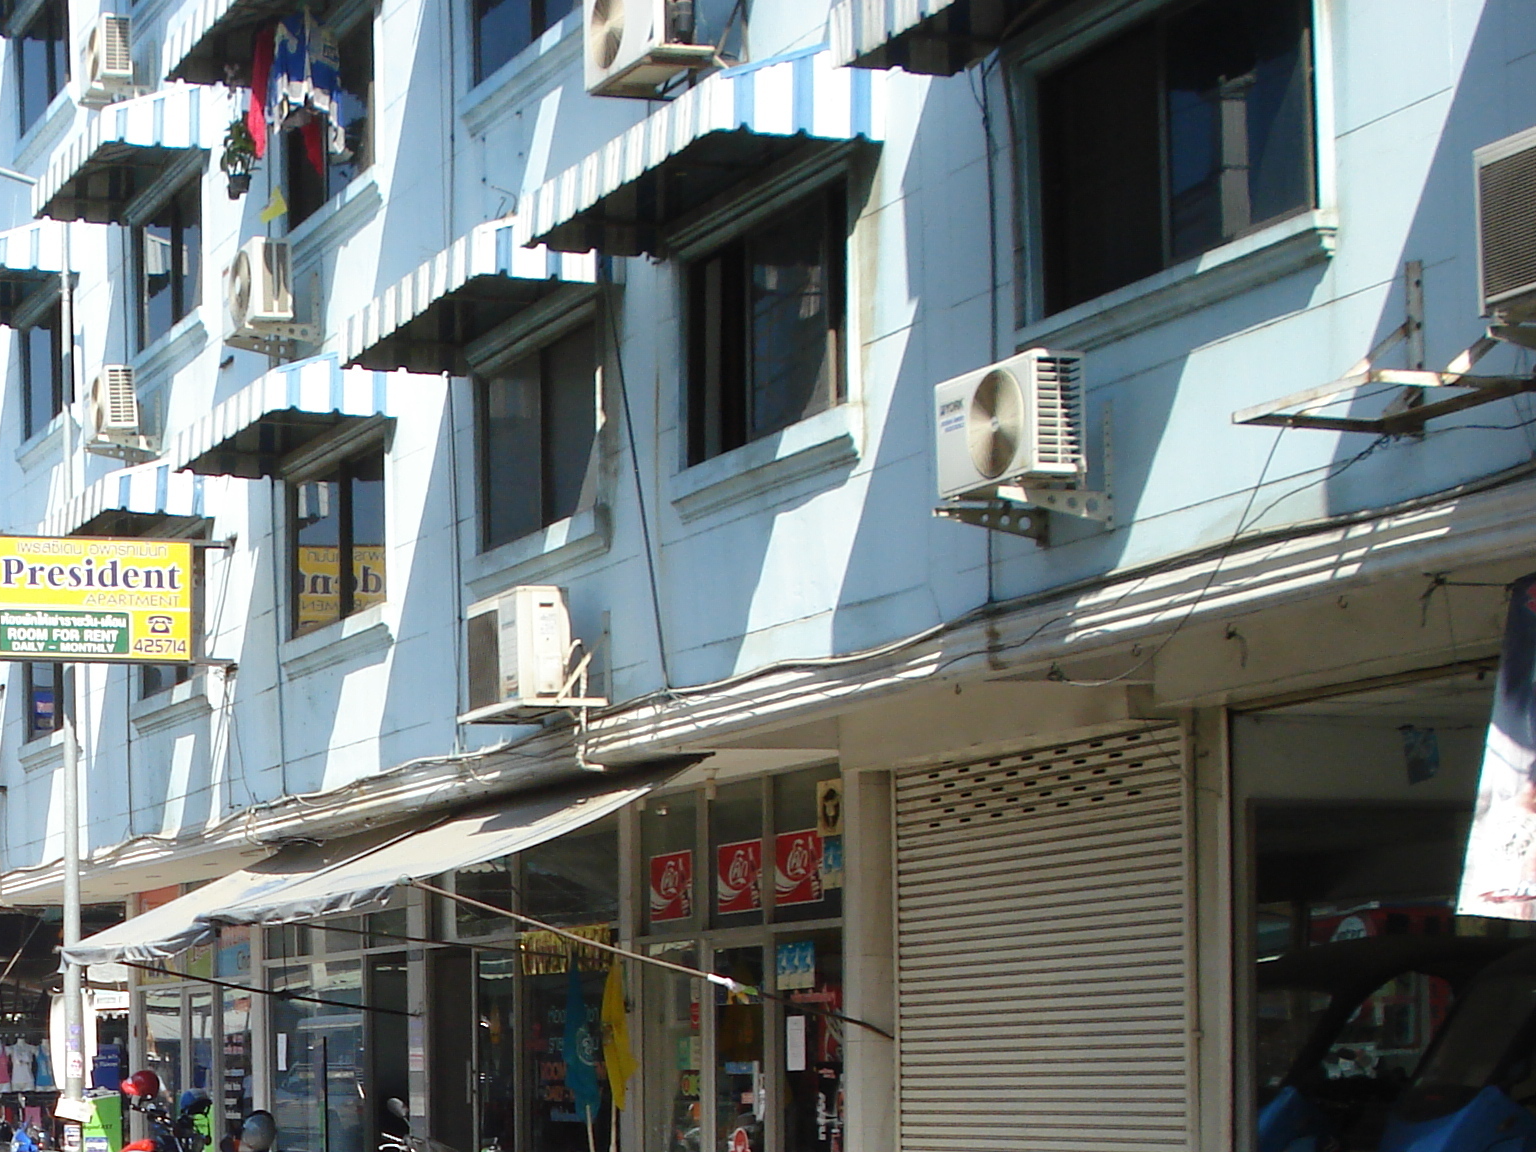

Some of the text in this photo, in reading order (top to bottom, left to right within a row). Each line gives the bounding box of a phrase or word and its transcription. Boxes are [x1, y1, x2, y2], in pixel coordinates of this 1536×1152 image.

[2, 558, 181, 590] President
[85, 594, 181, 607] APARTMENT
[7, 628, 119, 643] ROOM FOR RENT
[12, 642, 45, 652] DAILY
[60, 642, 115, 653] MONTHLY
[134, 639, 187, 653] 425714
